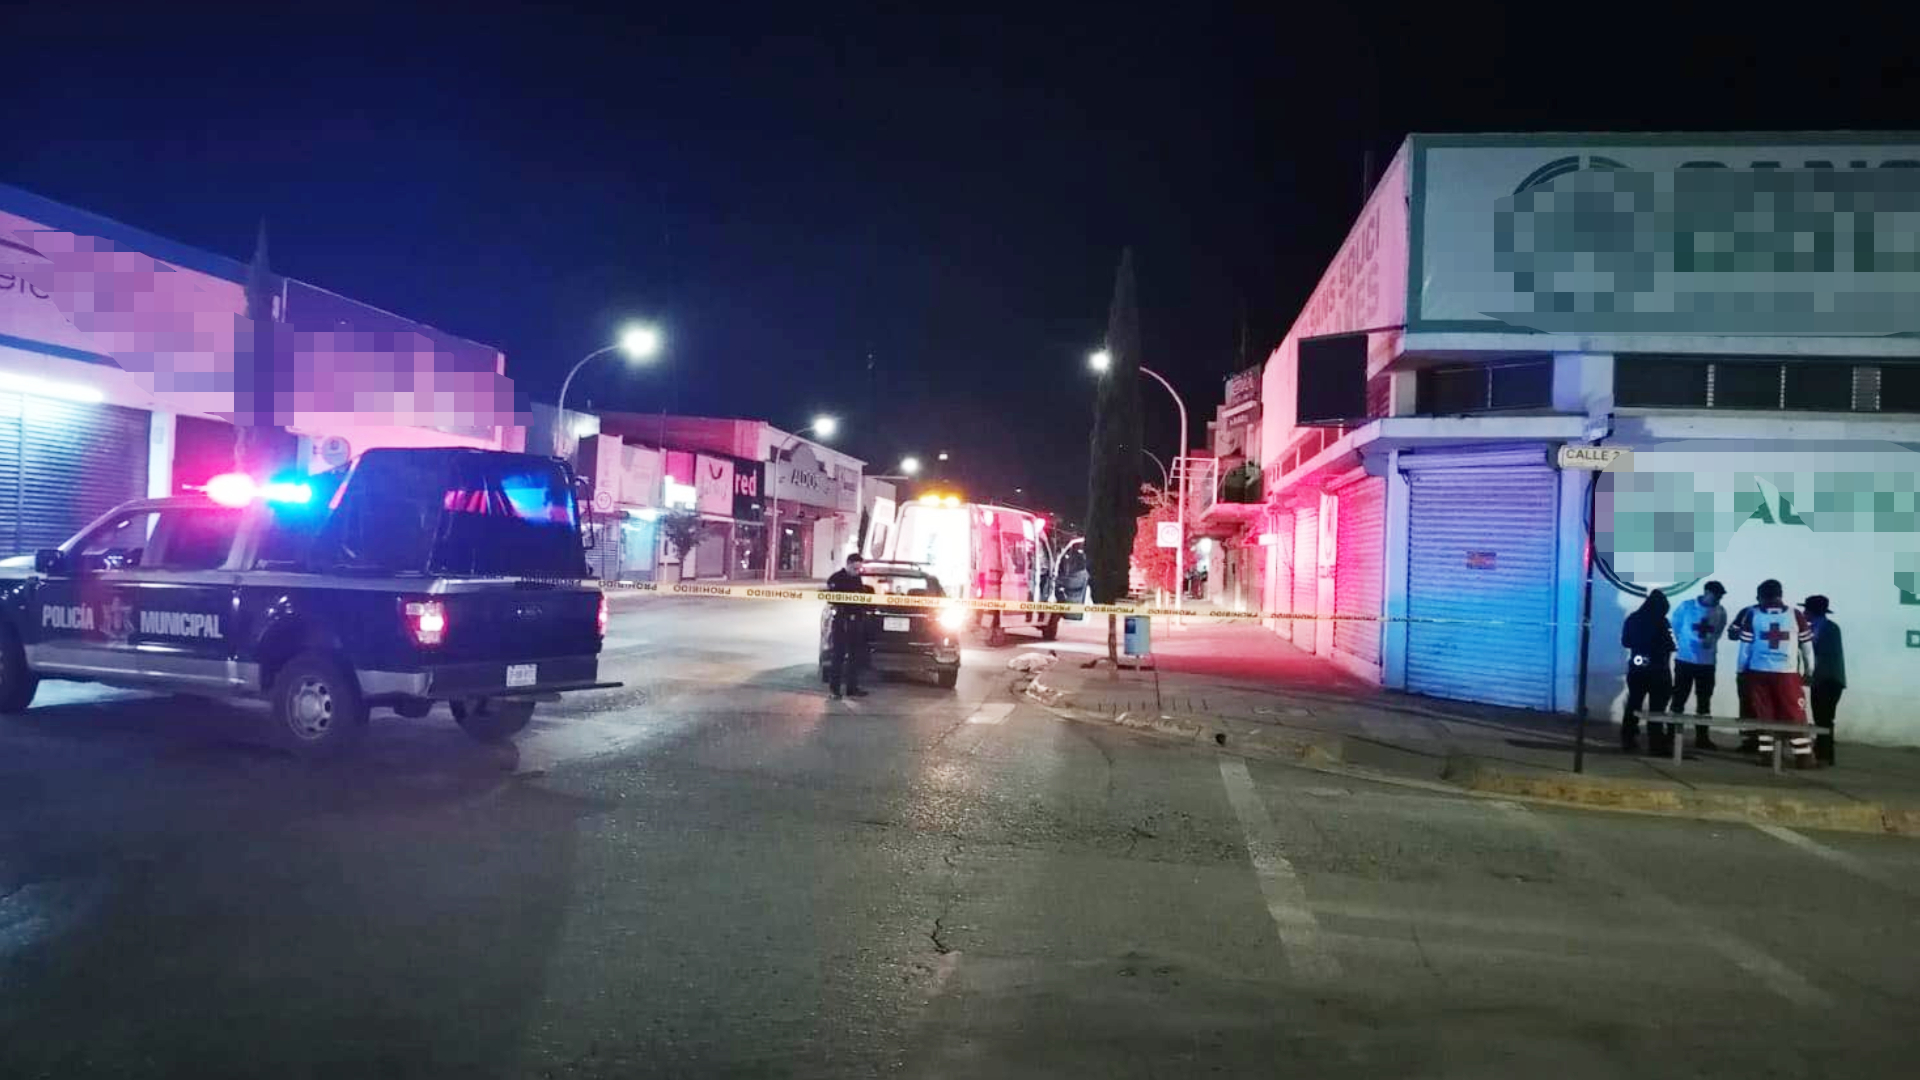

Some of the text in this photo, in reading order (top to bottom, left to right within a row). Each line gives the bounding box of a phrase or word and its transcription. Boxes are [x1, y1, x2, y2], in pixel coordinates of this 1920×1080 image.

[1566, 449, 1609, 461] CALLE
[735, 469, 757, 497] red
[673, 584, 731, 595] PROHIBIDO
[746, 588, 803, 599] PROHIBIDO
[817, 592, 872, 603] PROHIBIDO
[1020, 603, 1071, 612] PROHIBIDO
[1084, 605, 1134, 614] PROHIBIDO
[1147, 608, 1197, 616] PROHIBIDO
[42, 602, 223, 639] POLICÍA MUNICIPAL
